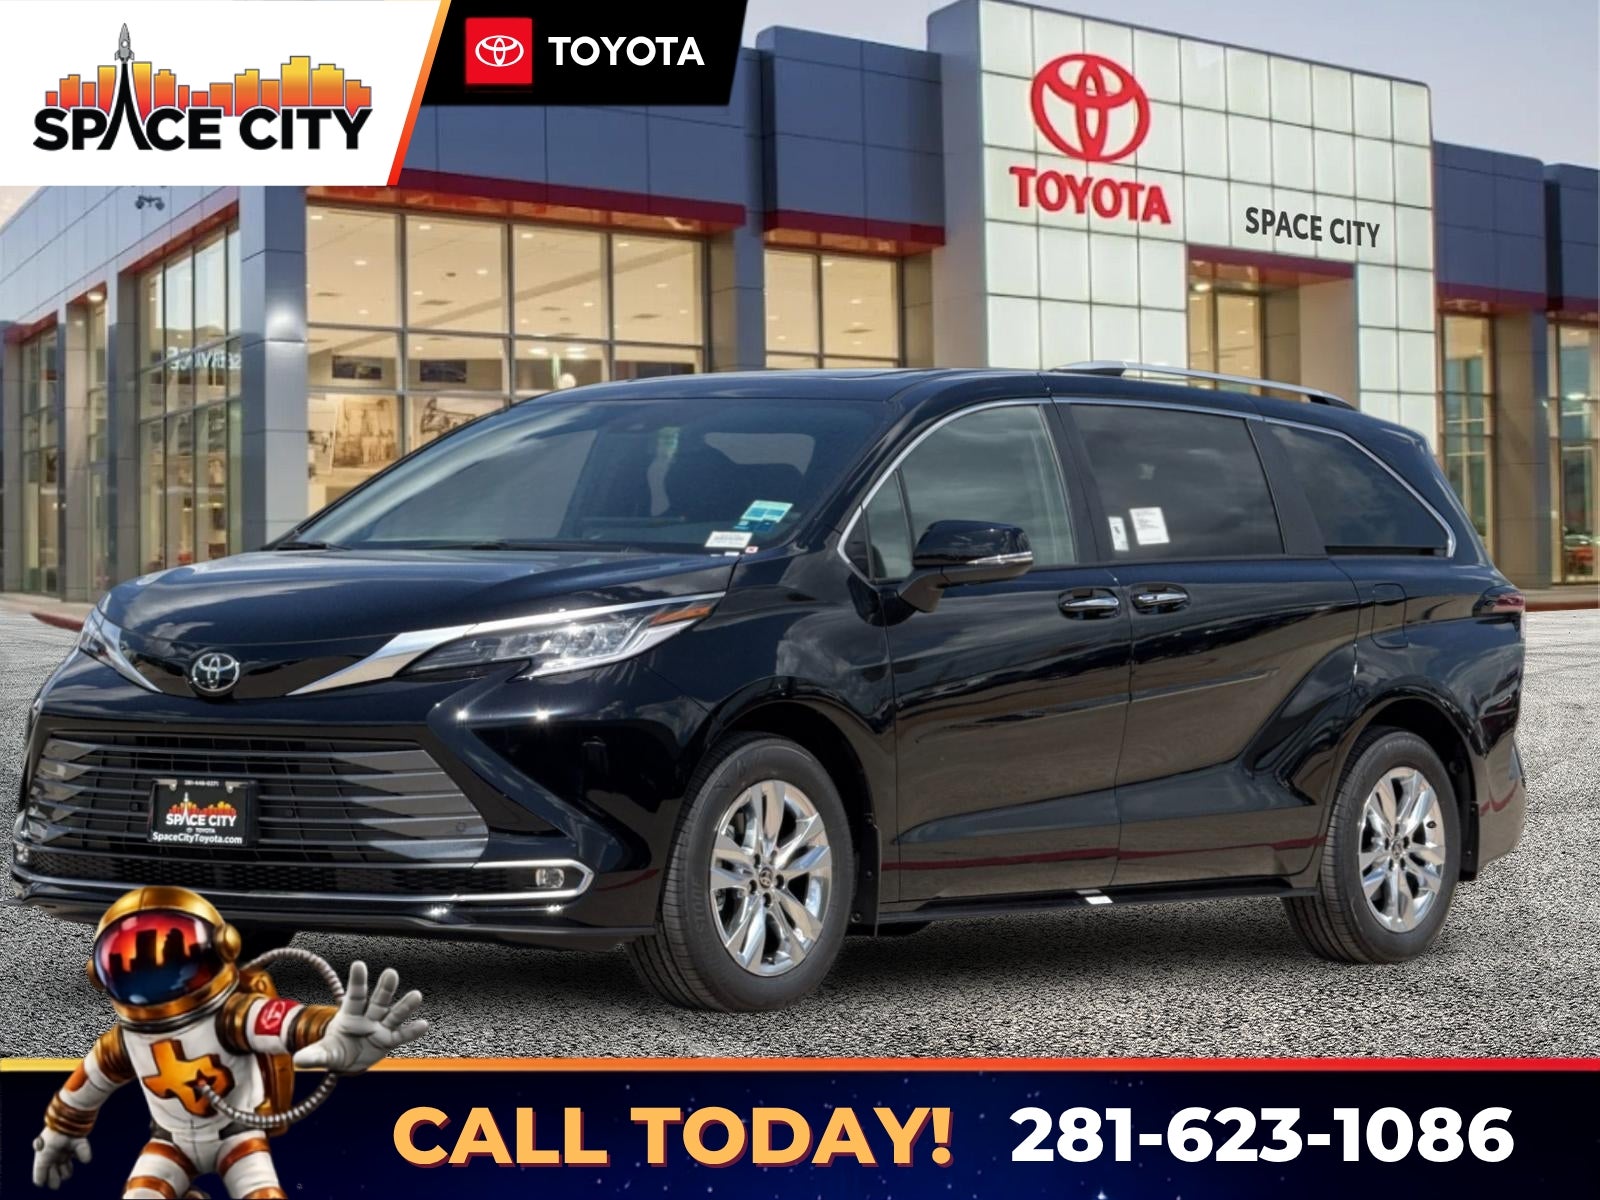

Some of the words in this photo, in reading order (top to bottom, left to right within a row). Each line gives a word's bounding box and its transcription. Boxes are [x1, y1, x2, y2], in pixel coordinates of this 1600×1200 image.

[1009, 166, 1171, 224] TOYOTA
[1245, 206, 1323, 242] SPACE
[1329, 217, 1381, 248] CITY
[165, 813, 206, 826] SPACE
[208, 814, 237, 827] CITY
[152, 831, 243, 845] SpaceCityToyota.com
